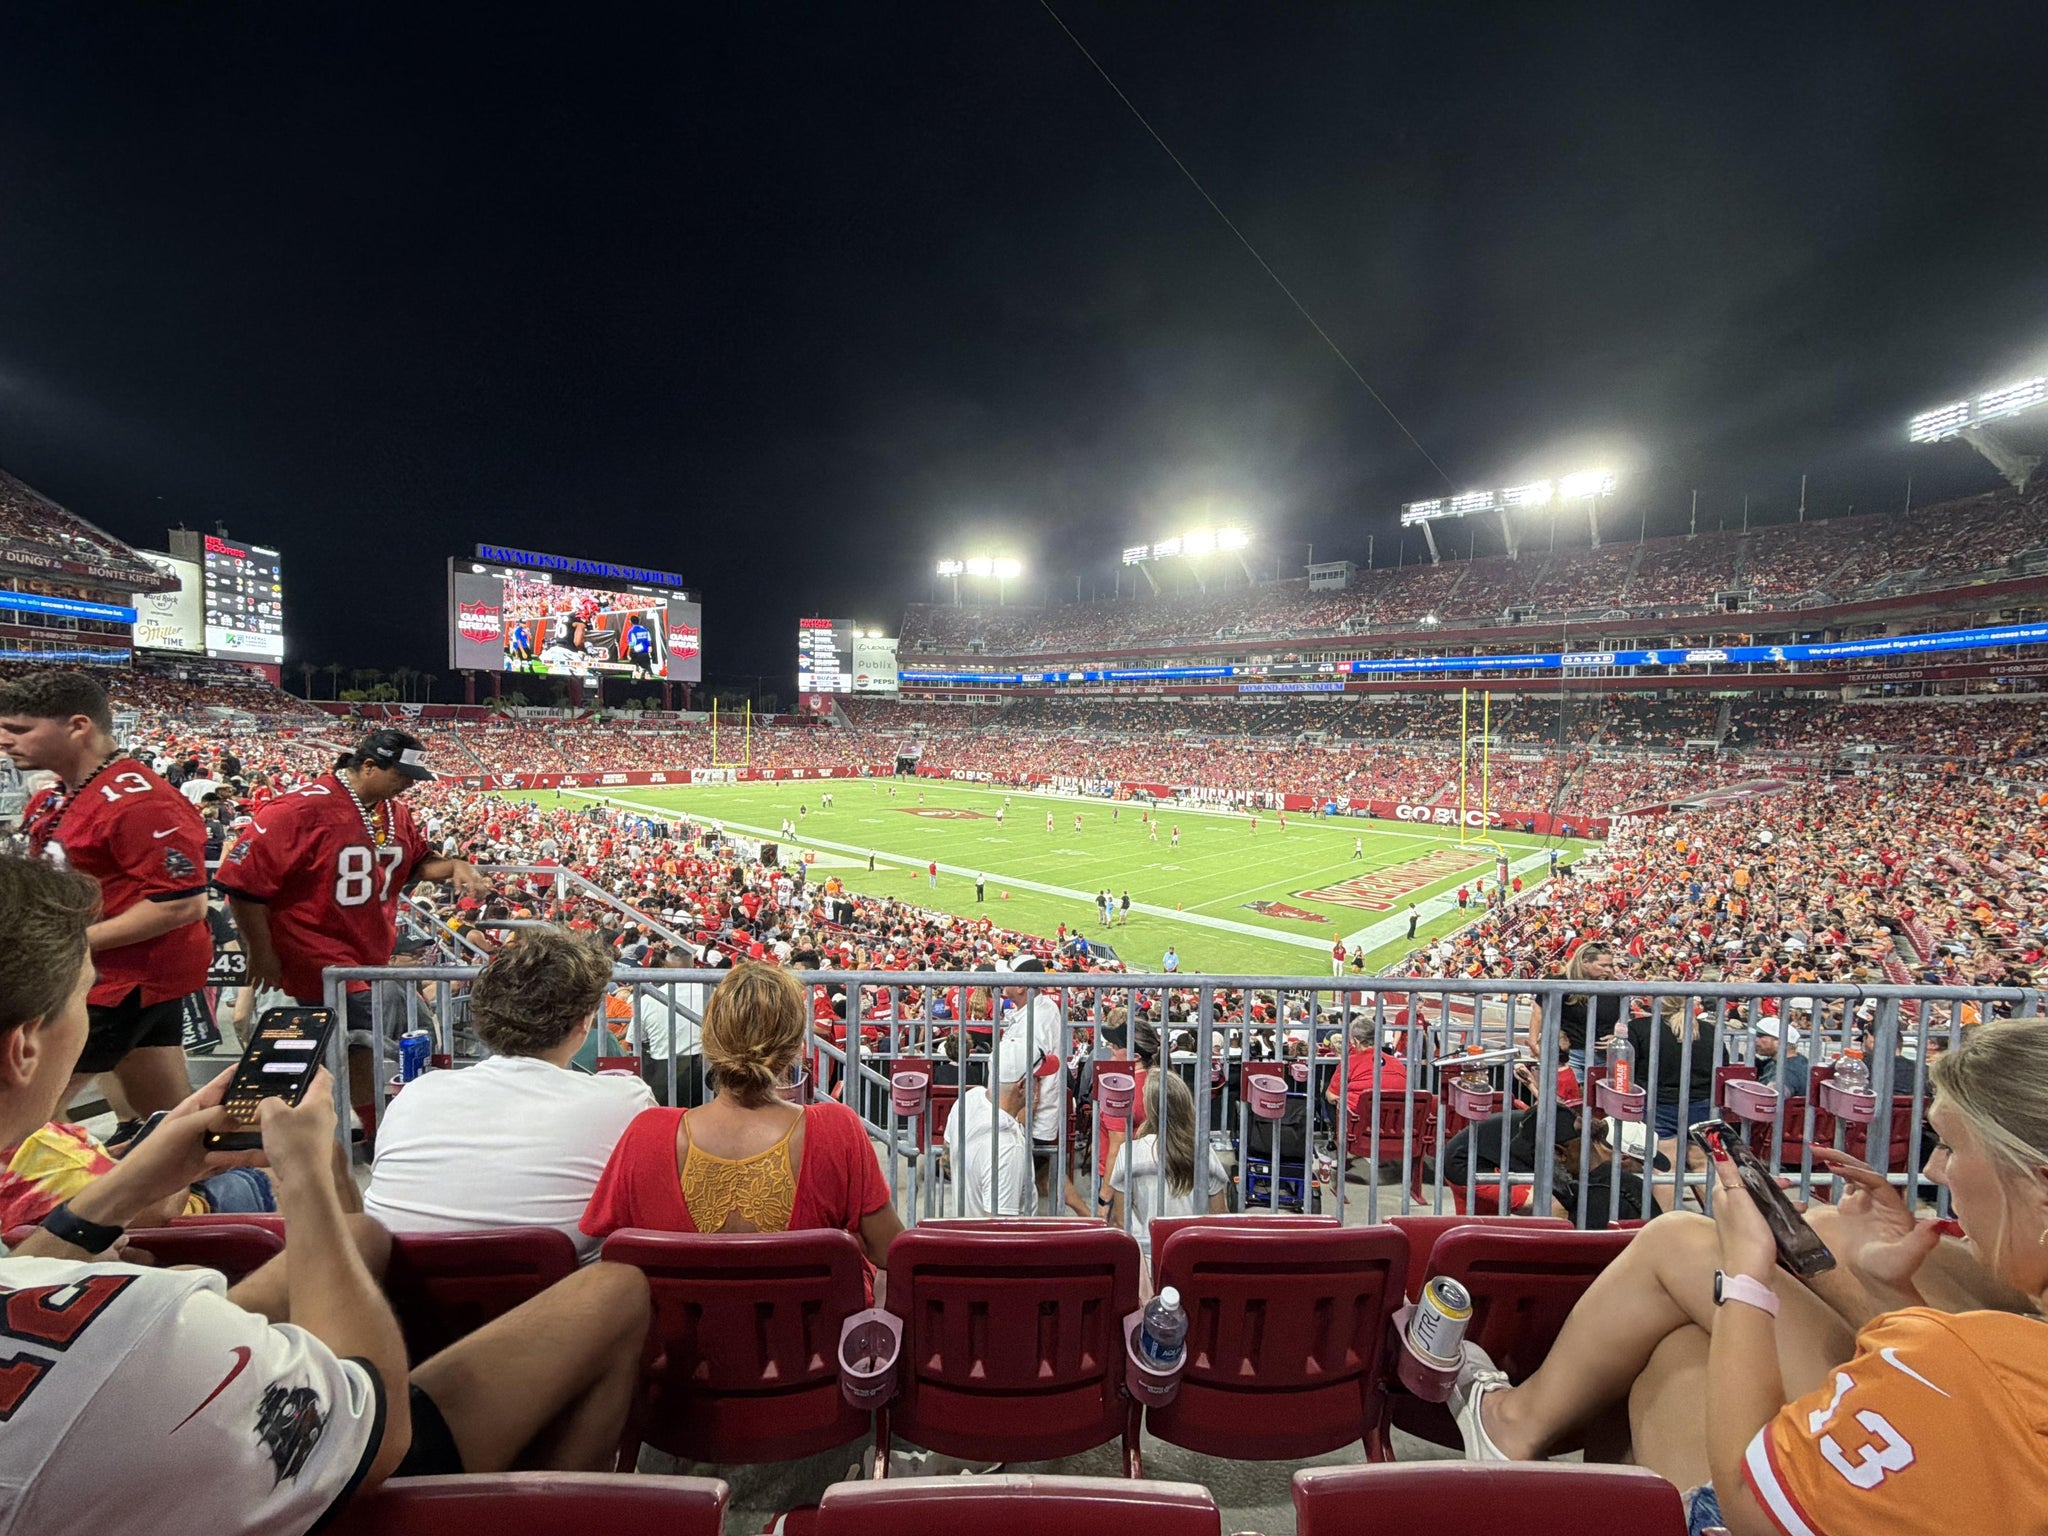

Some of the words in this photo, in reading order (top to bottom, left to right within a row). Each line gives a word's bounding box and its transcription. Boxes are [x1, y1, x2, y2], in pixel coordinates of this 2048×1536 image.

[7, 551, 52, 568] DUNGY
[481, 546, 568, 569] RAYMOND
[571, 560, 620, 577] JAMES
[622, 567, 682, 586] STADIUM
[88, 566, 127, 581] MONTE
[129, 573, 160, 586] KIFFIN
[460, 613, 499, 624] GAME
[458, 620, 501, 632] BREAK
[137, 625, 184, 642] Miller
[163, 637, 184, 647] TIME
[668, 640, 700, 650] BREAK
[858, 660, 892, 669] Publix
[1686, 653, 1727, 662] GEICO
[1882, 671, 1910, 680] ISSUES
[1280, 683, 1306, 691] JAMES
[1307, 683, 1344, 691] STADIUM
[100, 772, 153, 802] 13
[1395, 804, 1431, 820] GO
[336, 846, 403, 907] 87
[1808, 1371, 1916, 1491] 13
